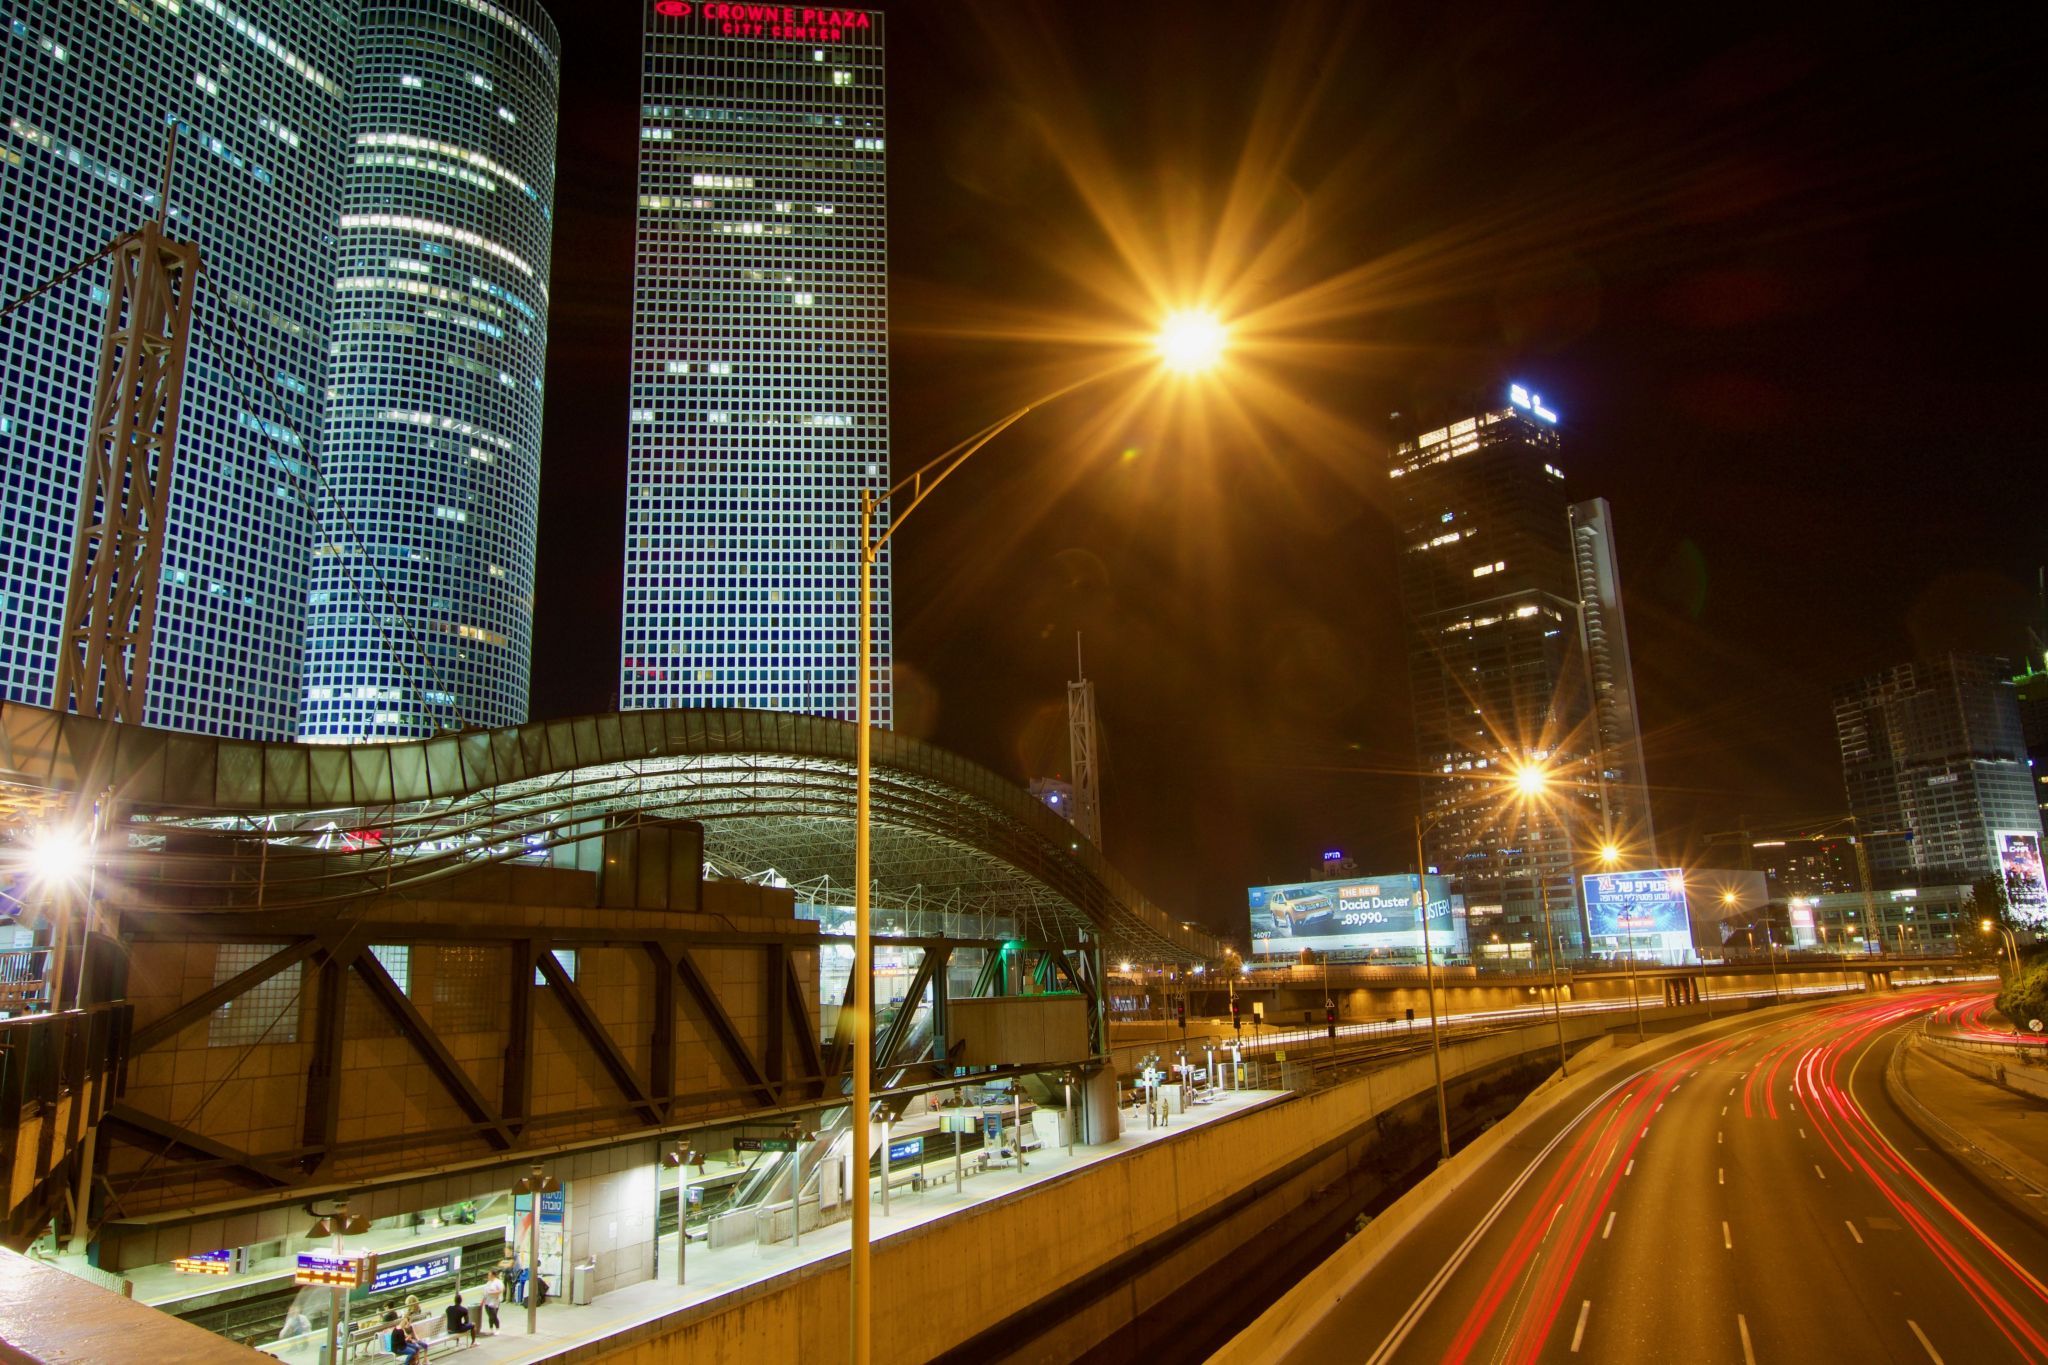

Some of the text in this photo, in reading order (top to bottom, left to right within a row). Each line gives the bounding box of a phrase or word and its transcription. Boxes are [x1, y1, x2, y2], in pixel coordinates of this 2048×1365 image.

[703, 3, 795, 24] CROWNE
[803, 10, 869, 28] PLAZA
[722, 22, 841, 40] CITY CENTER
[1341, 887, 1377, 896] THE NEW
[1340, 897, 1409, 911] Dacia Duster
